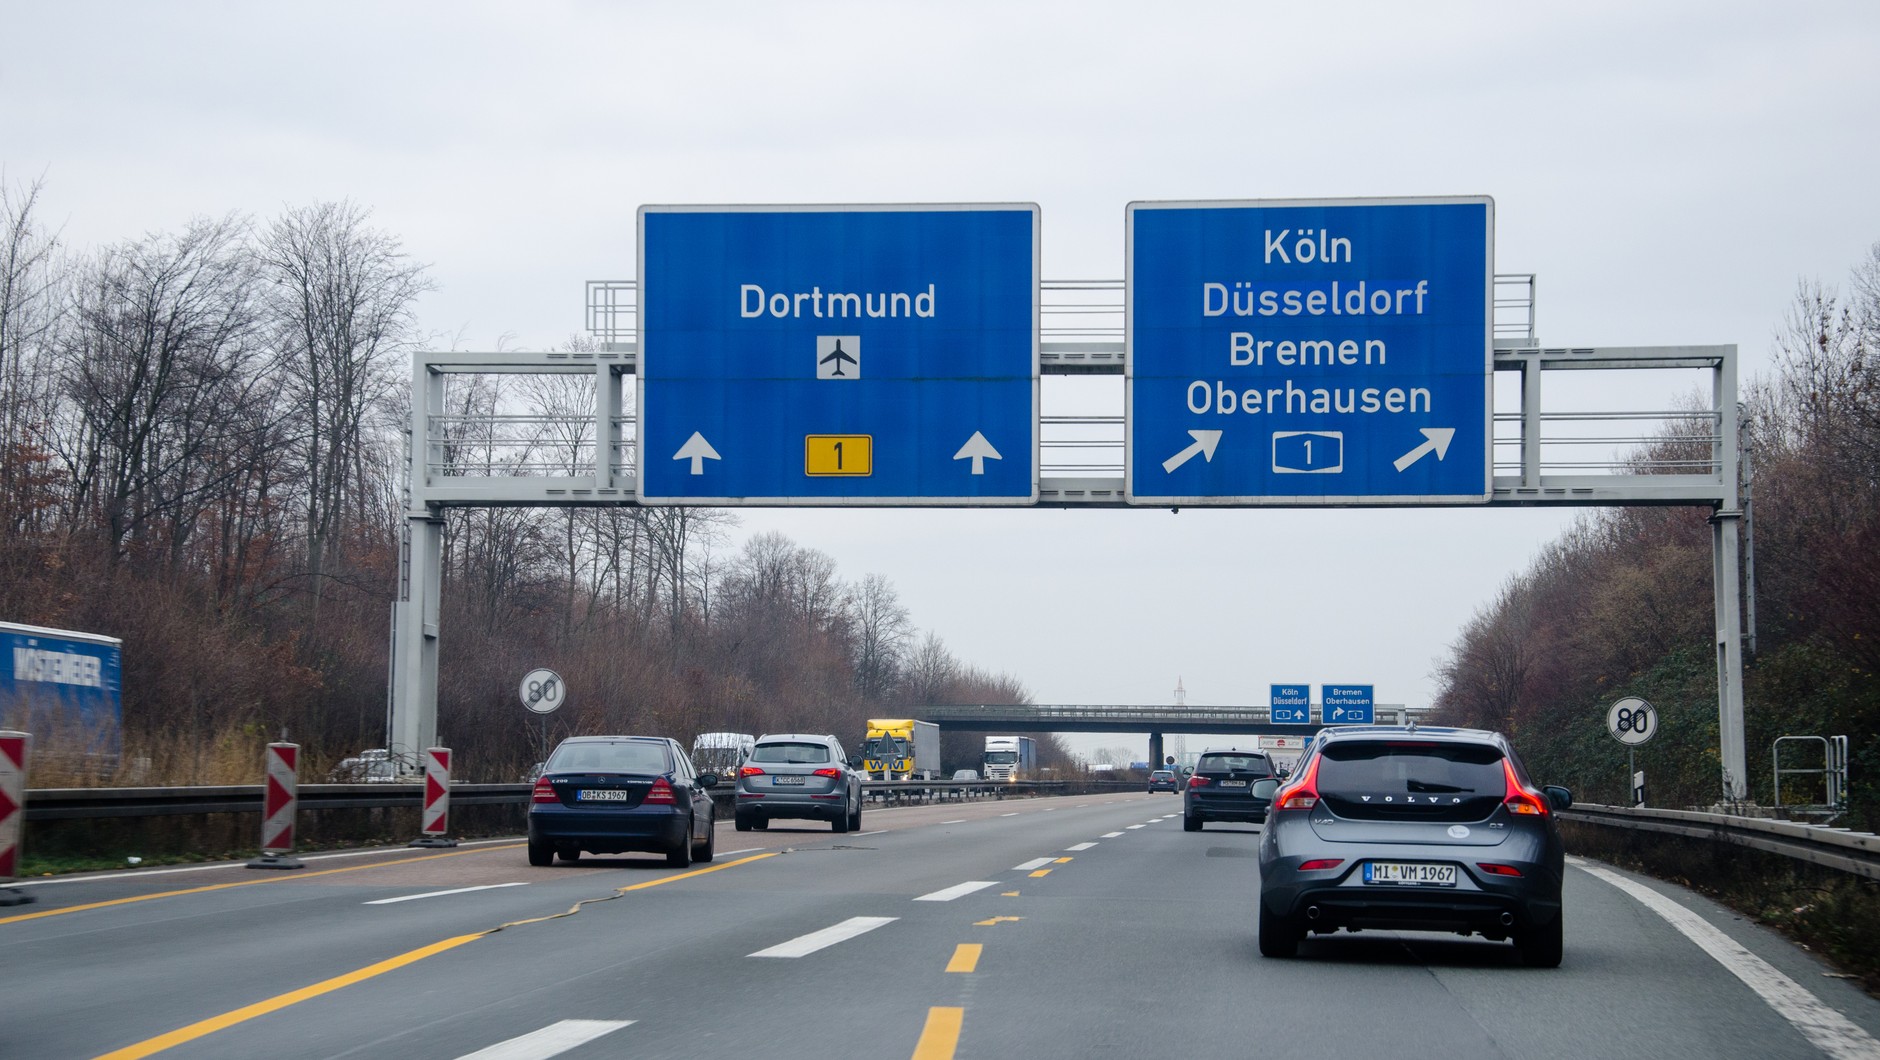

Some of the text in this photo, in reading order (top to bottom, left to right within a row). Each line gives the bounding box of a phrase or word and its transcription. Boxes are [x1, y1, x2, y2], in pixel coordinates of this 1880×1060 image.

[1265, 229, 1352, 264] Köln
[740, 284, 935, 318] Dortmund
[1204, 281, 1428, 317] Düsseldorf
[1230, 332, 1386, 366] Bremen
[1187, 380, 1431, 415] Oberhausen
[833, 442, 843, 470] 1
[1303, 440, 1312, 465] 1
[528, 680, 556, 702] 80
[1273, 696, 1307, 705] Düsseldorf
[1325, 697, 1370, 705] Oberhausen
[1333, 688, 1362, 696] Bremen
[1617, 708, 1647, 733] 80
[582, 791, 626, 800] OB KS 1967
[1361, 795, 1461, 803] VOLVO
[1373, 864, 1389, 879] MI
[1400, 865, 1417, 880] VM
[1420, 866, 1453, 881] 1967
